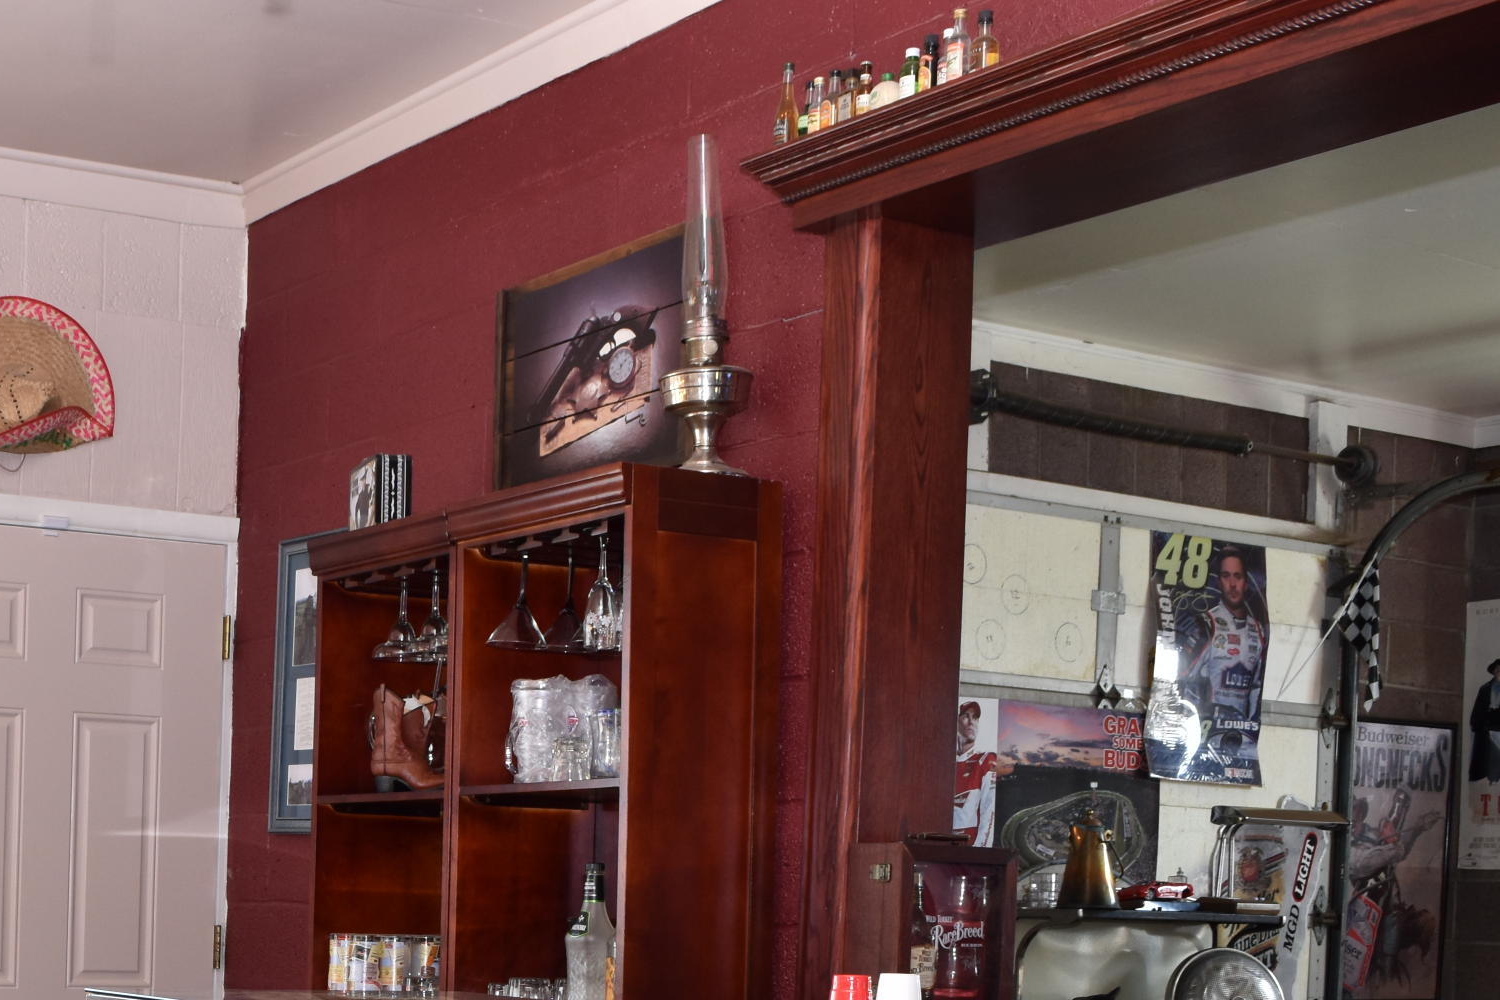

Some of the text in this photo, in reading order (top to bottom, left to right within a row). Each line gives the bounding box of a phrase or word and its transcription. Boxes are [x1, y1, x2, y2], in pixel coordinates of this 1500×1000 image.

[1155, 532, 1213, 590] 48
[1103, 715, 1144, 737] GRA
[1357, 726, 1428, 747] Budweiser
[1112, 735, 1144, 750] SOME
[1283, 838, 1316, 953] MGD LIGHT
[954, 920, 985, 941] Breed
